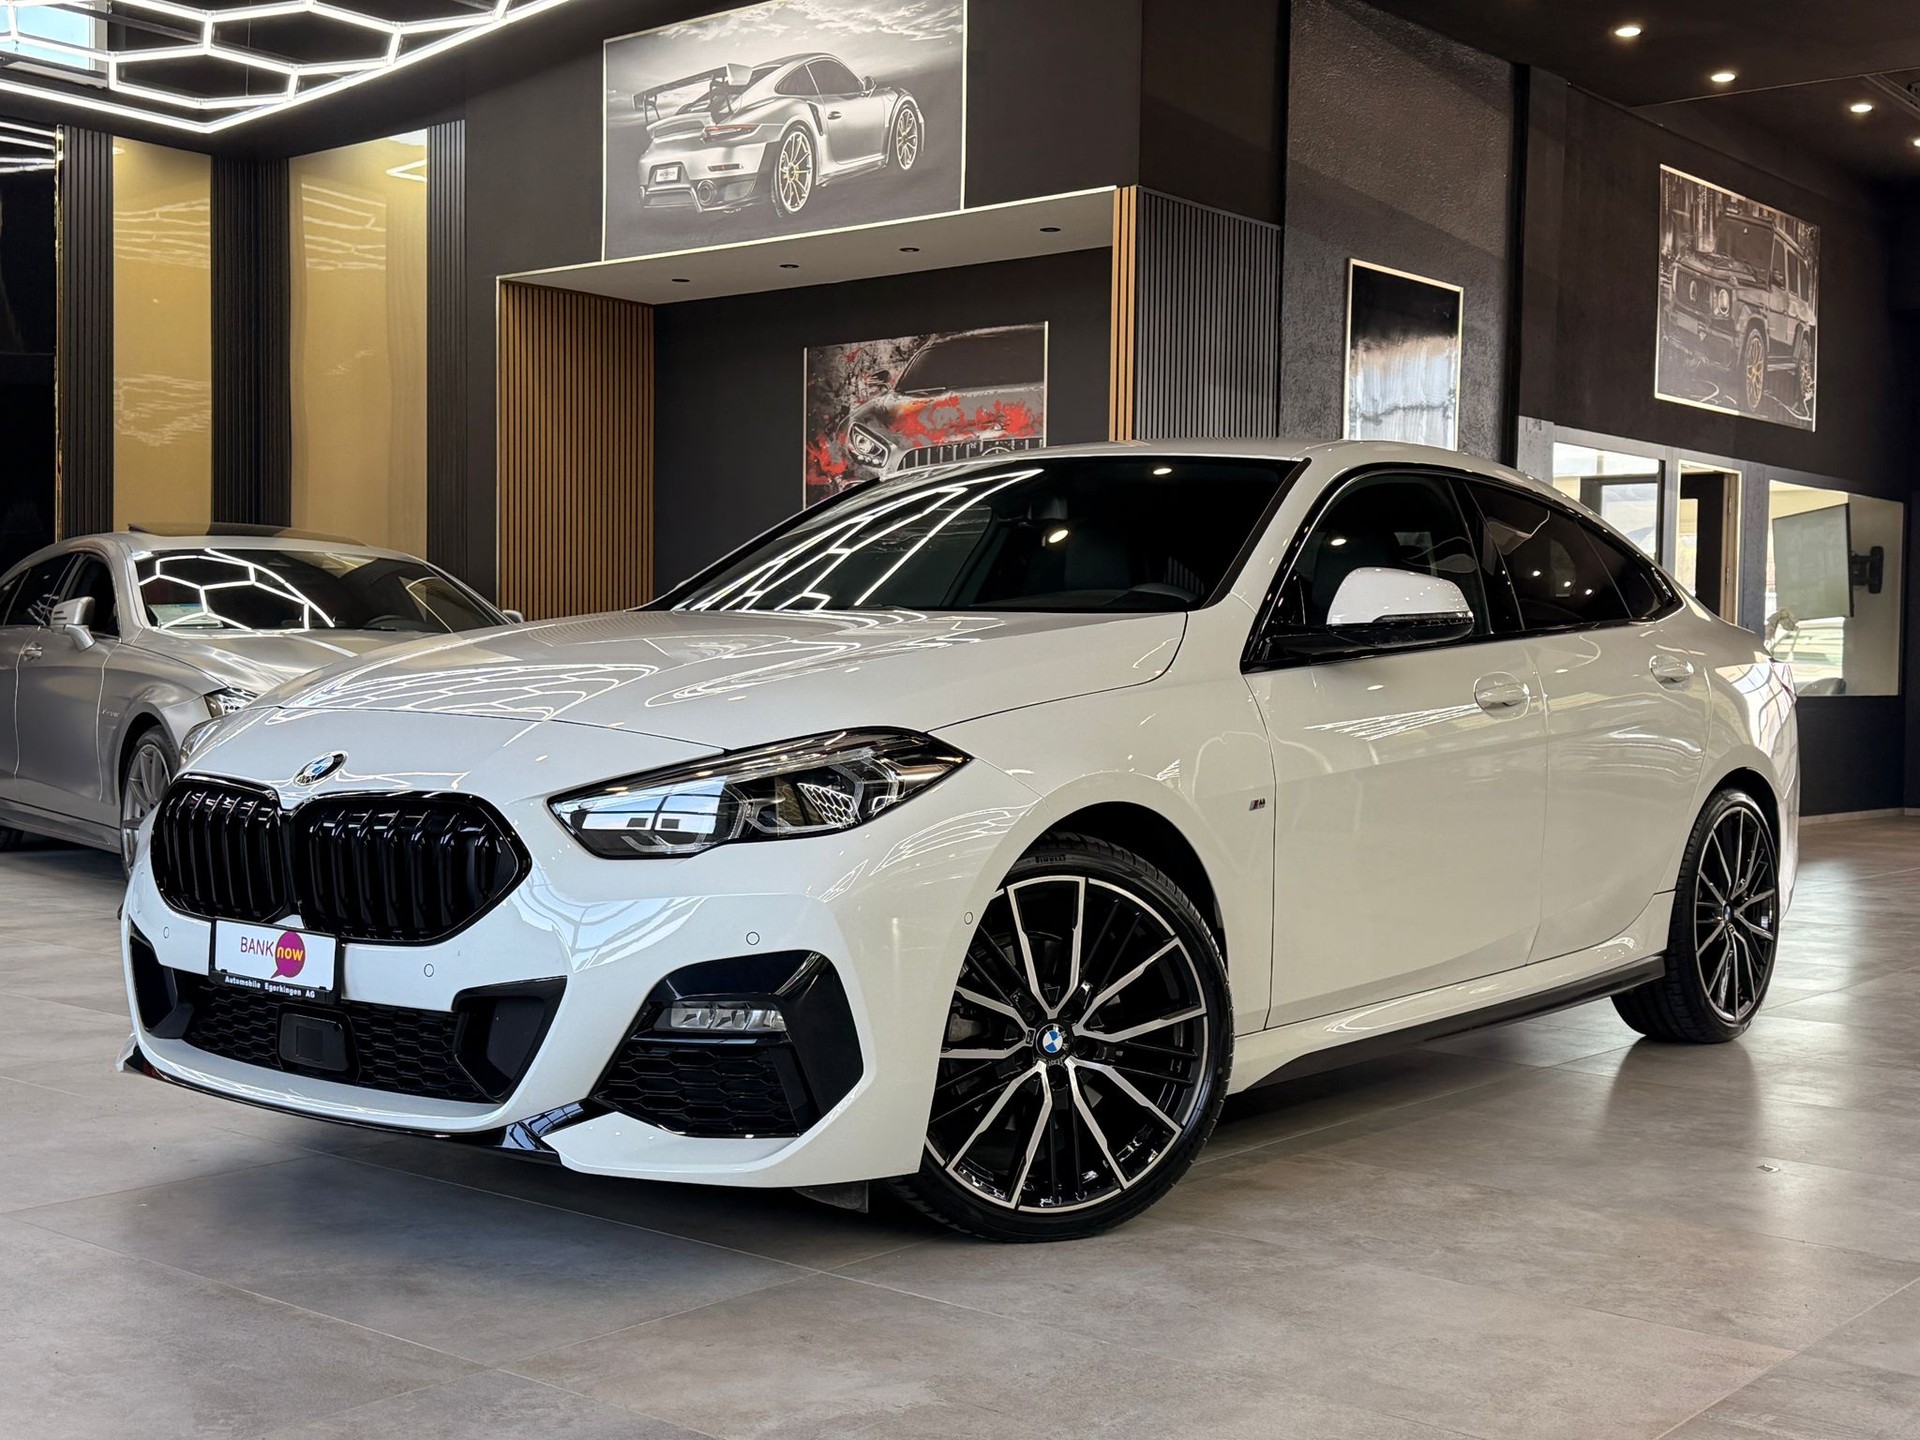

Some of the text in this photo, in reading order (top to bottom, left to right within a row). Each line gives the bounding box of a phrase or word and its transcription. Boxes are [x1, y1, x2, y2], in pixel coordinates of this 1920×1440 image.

[240, 936, 304, 961] BANK now
[224, 975, 316, 999] Automobile Egerkingen AG
